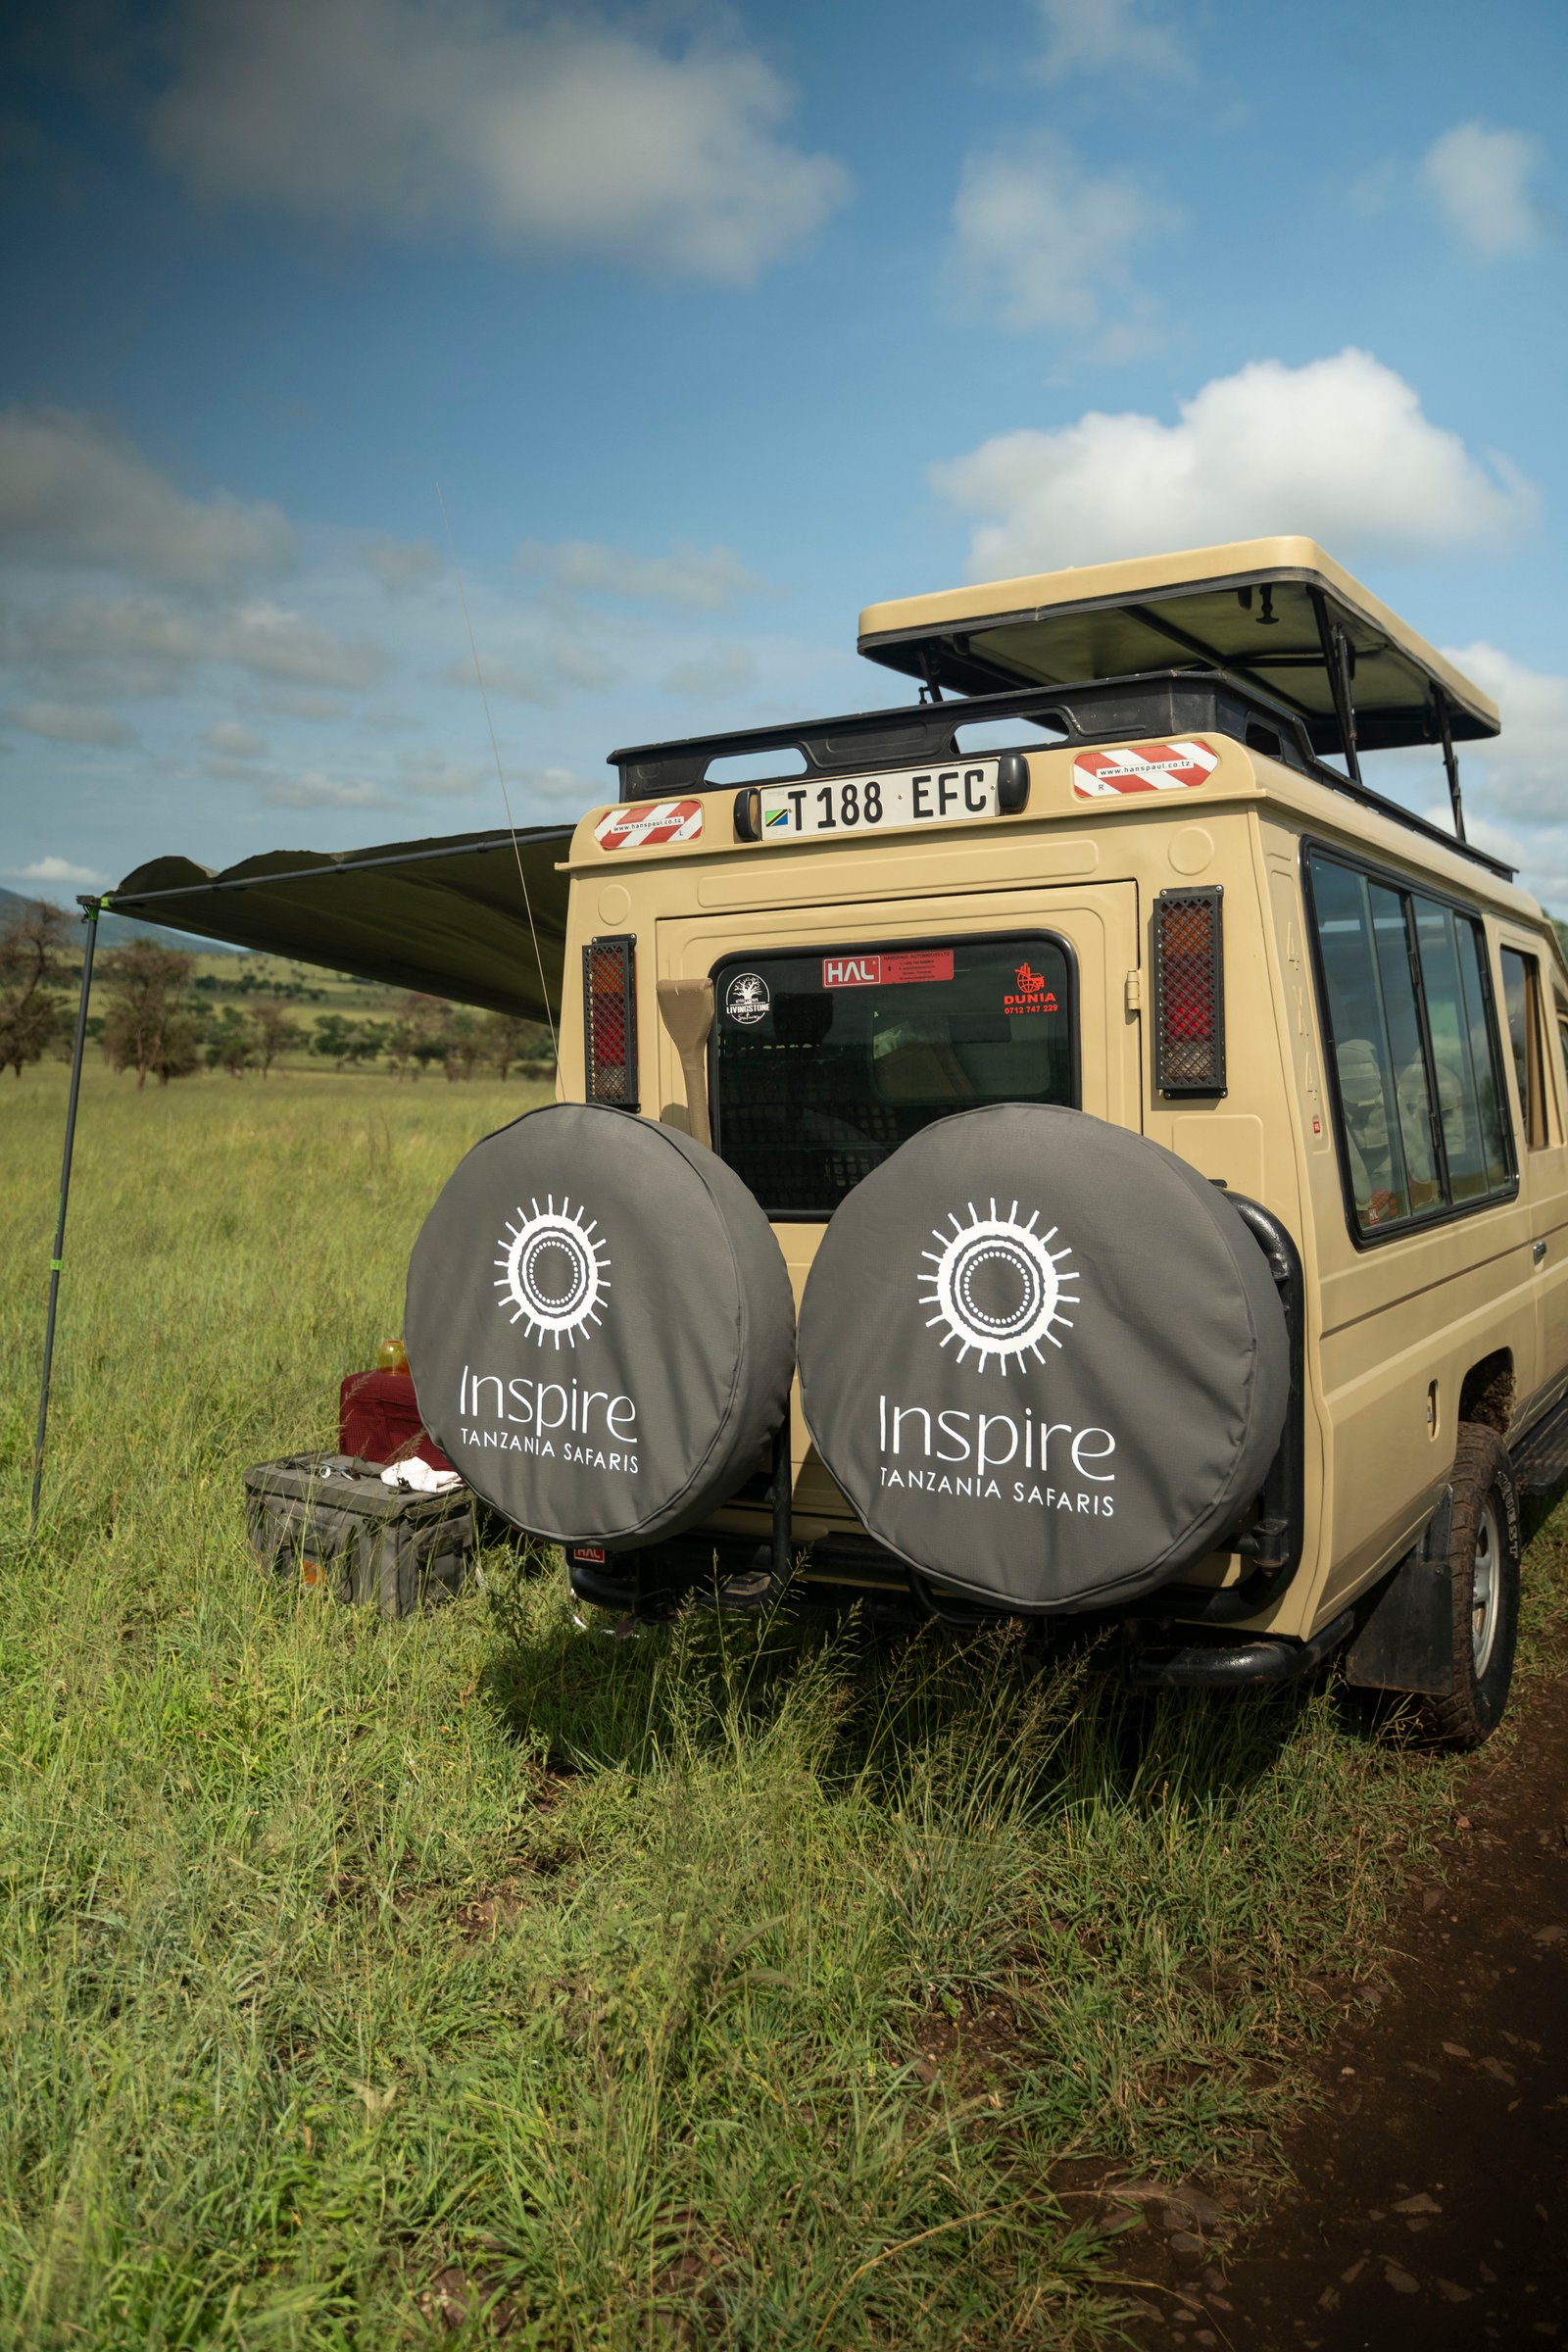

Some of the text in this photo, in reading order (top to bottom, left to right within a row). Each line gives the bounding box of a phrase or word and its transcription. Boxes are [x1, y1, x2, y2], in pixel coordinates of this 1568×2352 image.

[1100, 760, 1191, 776] www.hanspaul.co.tz
[911, 768, 987, 818] EFC
[613, 817, 681, 832] www.hanspaul.co.tz
[827, 960, 875, 983] HAL
[726, 1004, 770, 1014] LIVINGSTONE
[1004, 992, 1056, 1004] DUNIA
[460, 1365, 638, 1444] Inspire
[461, 1428, 639, 1474] TANZANIA SAFARIS
[879, 1395, 1116, 1482] Inspire
[880, 1466, 1115, 1517] TANZANIA SAFARIS
